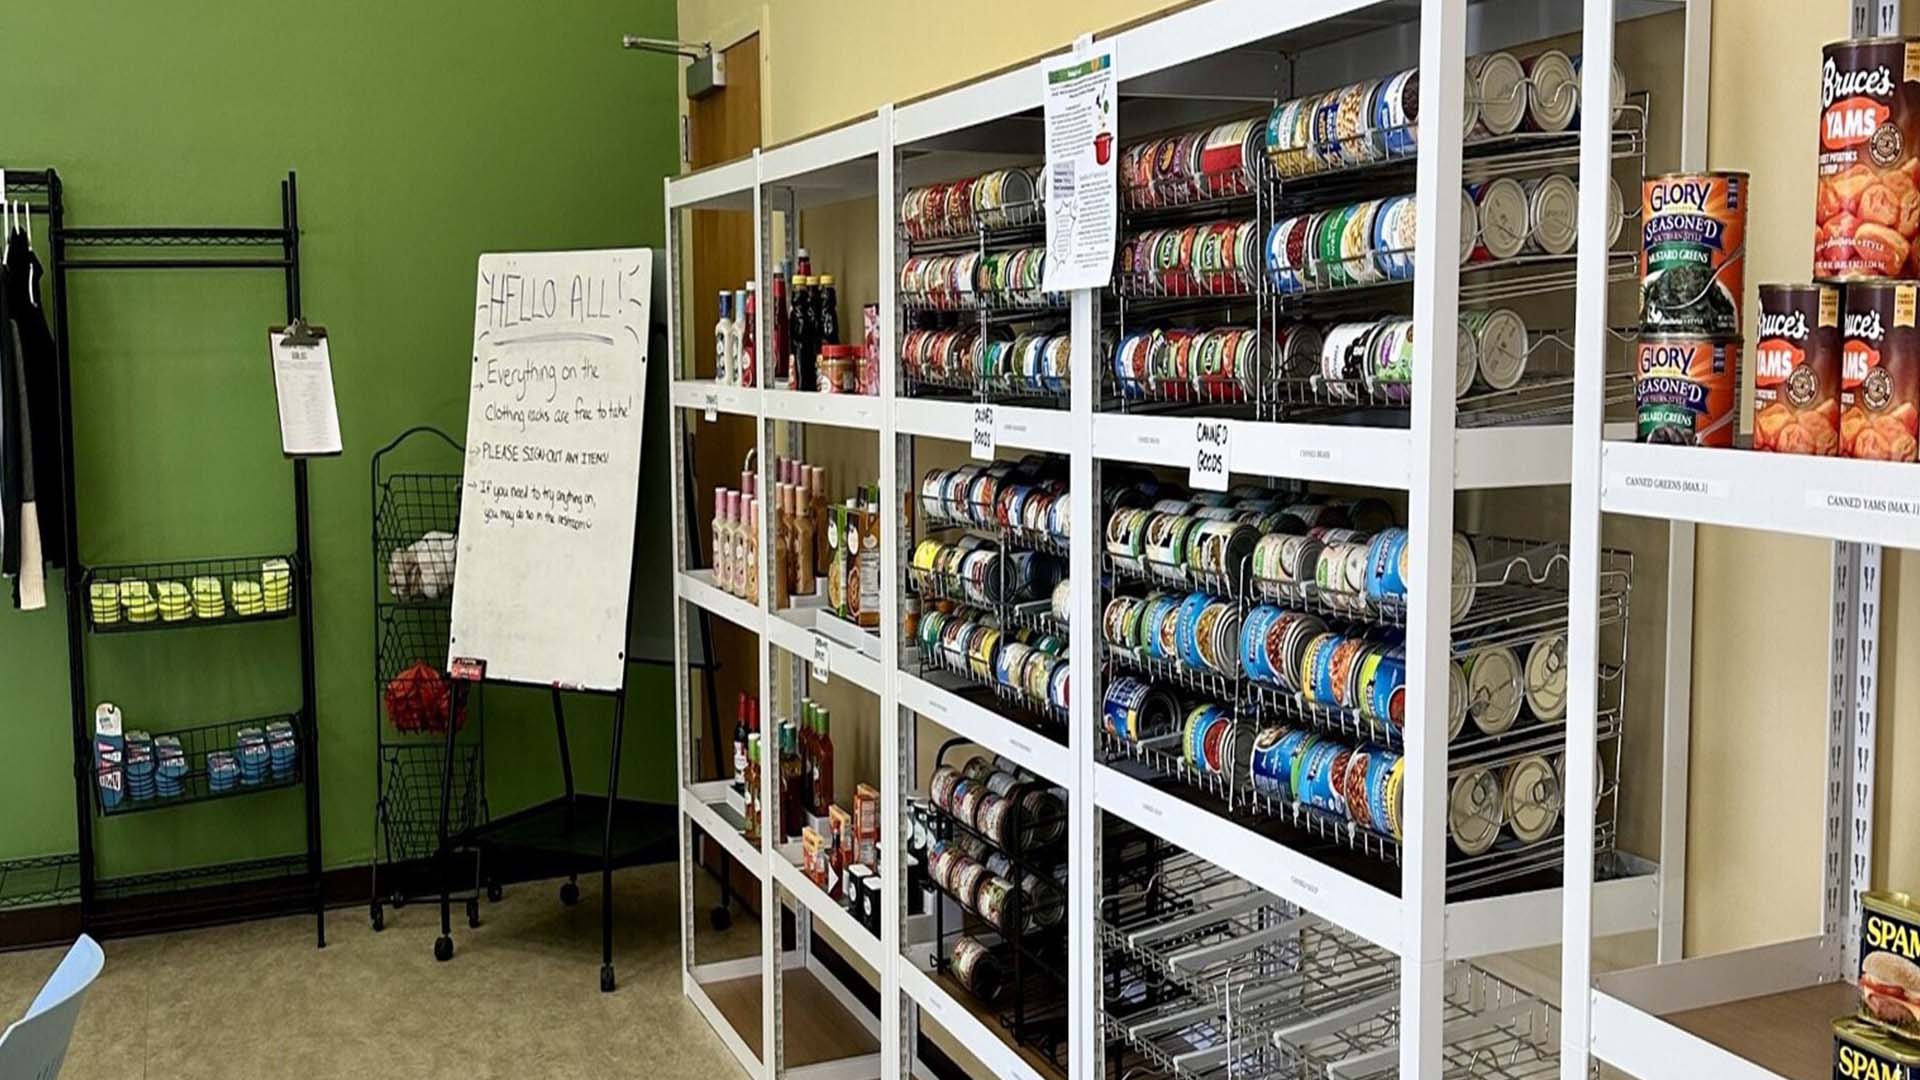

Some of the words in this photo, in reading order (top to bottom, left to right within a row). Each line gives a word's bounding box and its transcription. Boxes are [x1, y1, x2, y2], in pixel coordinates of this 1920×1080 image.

[1823, 57, 1894, 108] Bruce's
[1826, 107, 1877, 139] YAMS
[1650, 182, 1711, 212] GLORY
[1645, 214, 1718, 242] SEASONED
[1679, 249, 1708, 264] GREENS
[490, 273, 557, 328] HELLO
[1758, 302, 1809, 341] ruce's
[1844, 309, 1885, 339] uce's
[1641, 346, 1696, 375] GLORY
[1757, 350, 1793, 378] AMS
[1842, 351, 1868, 380] MS
[487, 358, 557, 402] Everything
[562, 365, 577, 380] on
[582, 356, 600, 379] the
[1638, 378, 1702, 402] SEASONED
[485, 403, 526, 433] Clothing
[528, 408, 550, 422] racks
[554, 409, 569, 424] are
[575, 396, 593, 421] free
[597, 400, 607, 419] to
[1196, 421, 1229, 446] CANNED
[482, 441, 518, 462] PLEASE
[565, 451, 579, 464] ANY
[1197, 448, 1223, 474] GOODS
[480, 479, 493, 493] If
[493, 485, 508, 503] you
[510, 484, 529, 499] need
[531, 484, 541, 500] to
[543, 484, 555, 509] try
[556, 489, 584, 513] anything
[1625, 475, 1653, 488] CANNED
[1653, 478, 1682, 492] GREENS
[484, 507, 499, 524] you
[500, 509, 515, 528] may
[516, 505, 524, 520] do
[1827, 494, 1862, 509] CANNED
[1862, 498, 1887, 512] YAMS
[1838, 1045, 1903, 1080] SPAM
